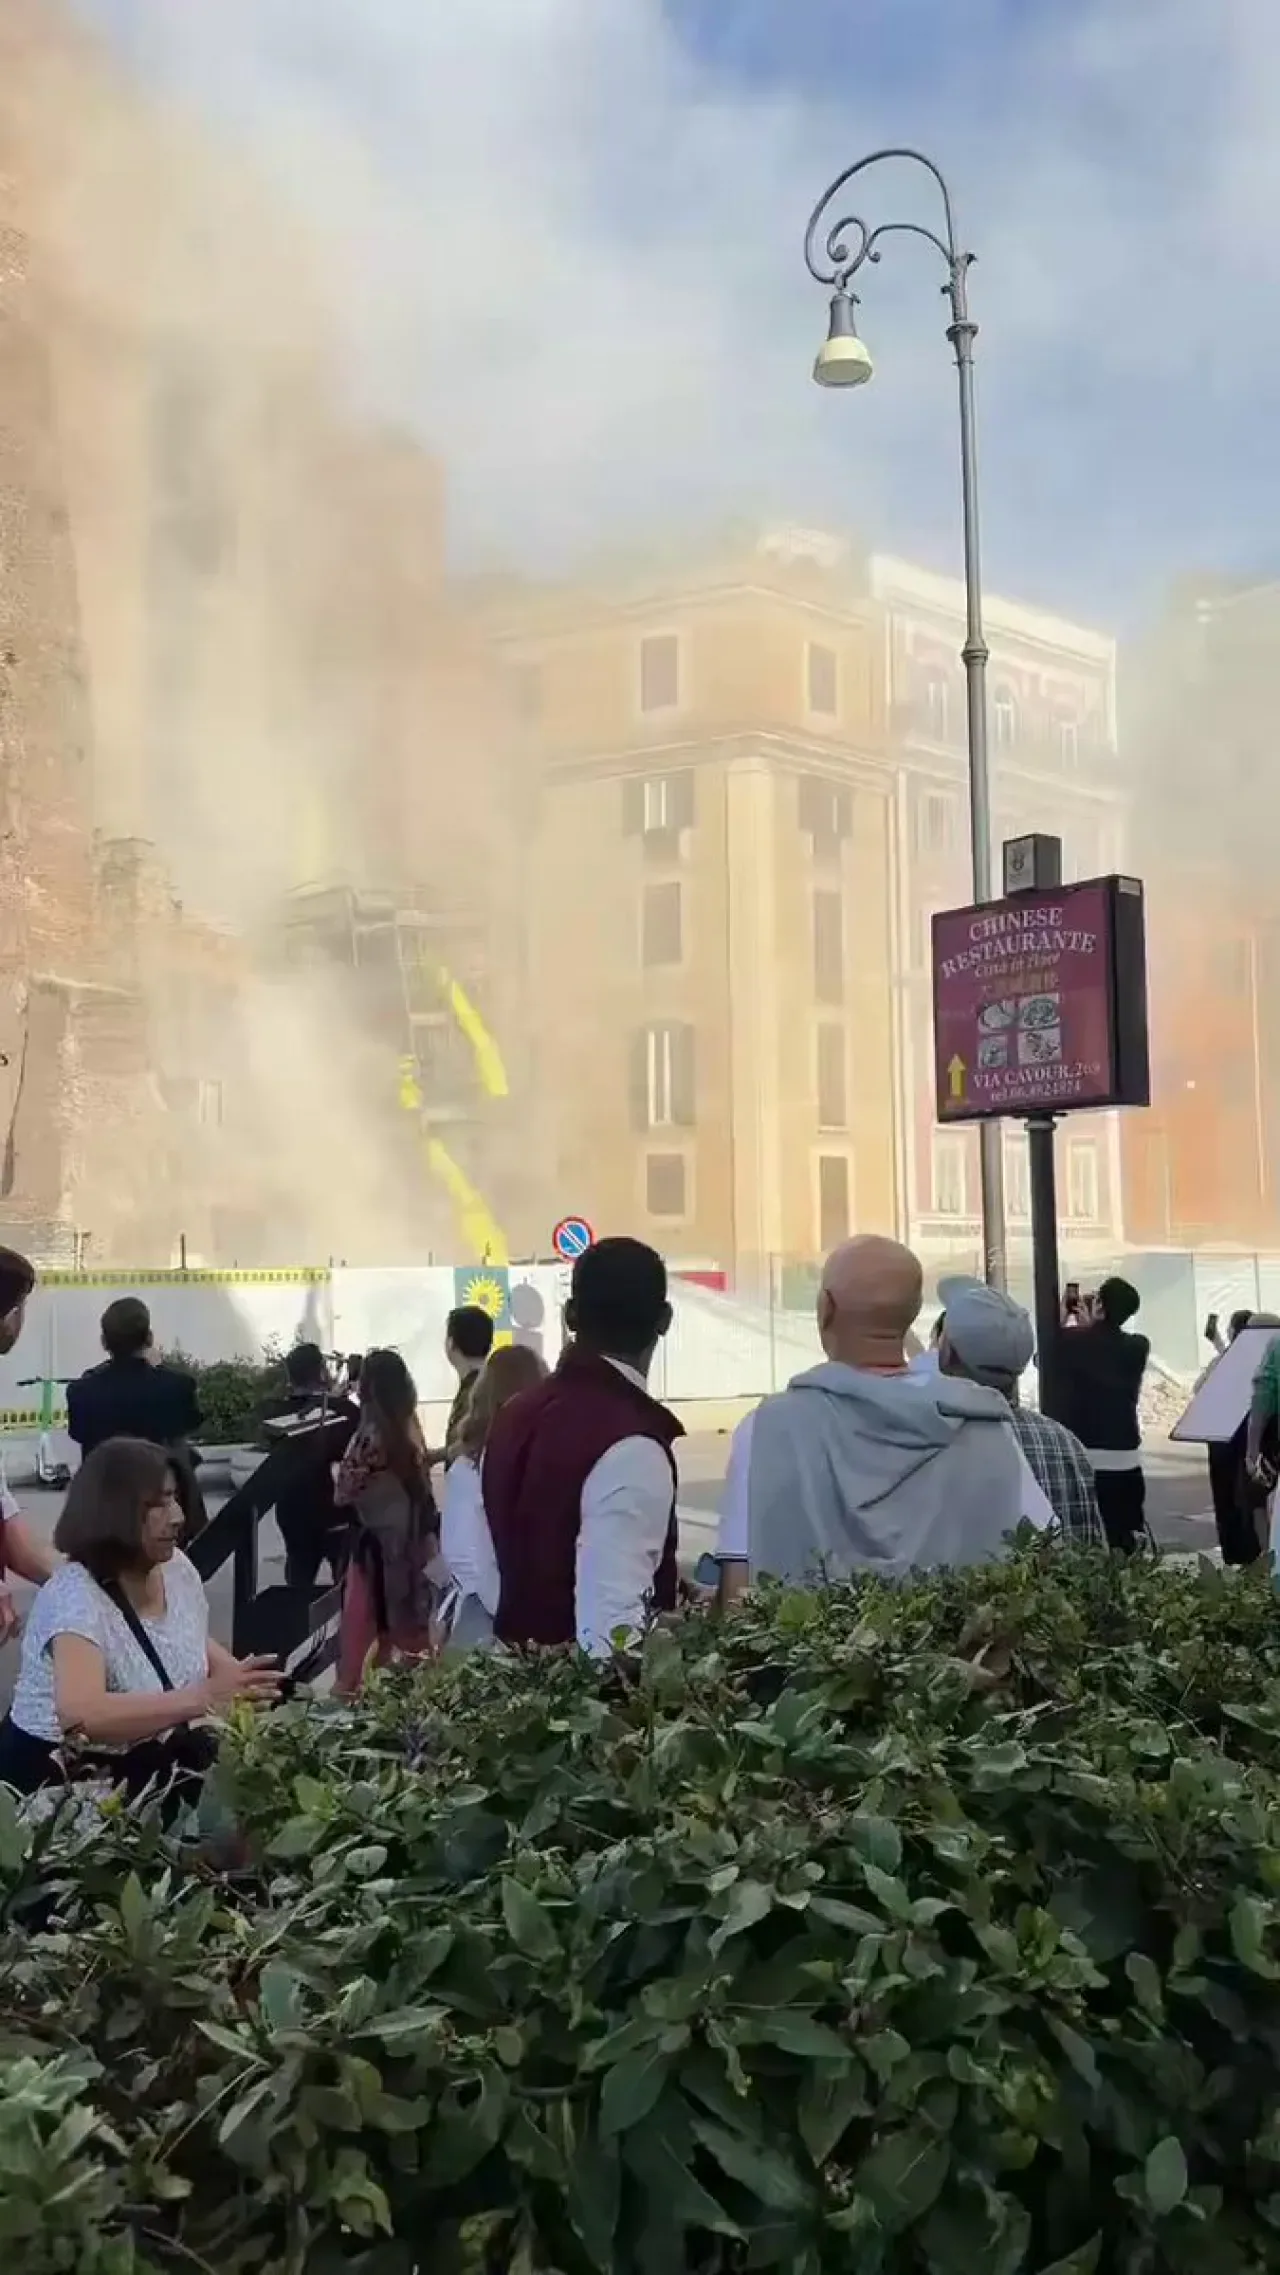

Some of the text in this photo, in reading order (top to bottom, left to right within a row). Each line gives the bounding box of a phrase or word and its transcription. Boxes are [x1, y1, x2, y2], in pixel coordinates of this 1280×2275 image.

[969, 907, 1063, 942] CHINESE
[941, 930, 1097, 979] RESTAURANTE
[973, 1072, 1001, 1089] VIA
